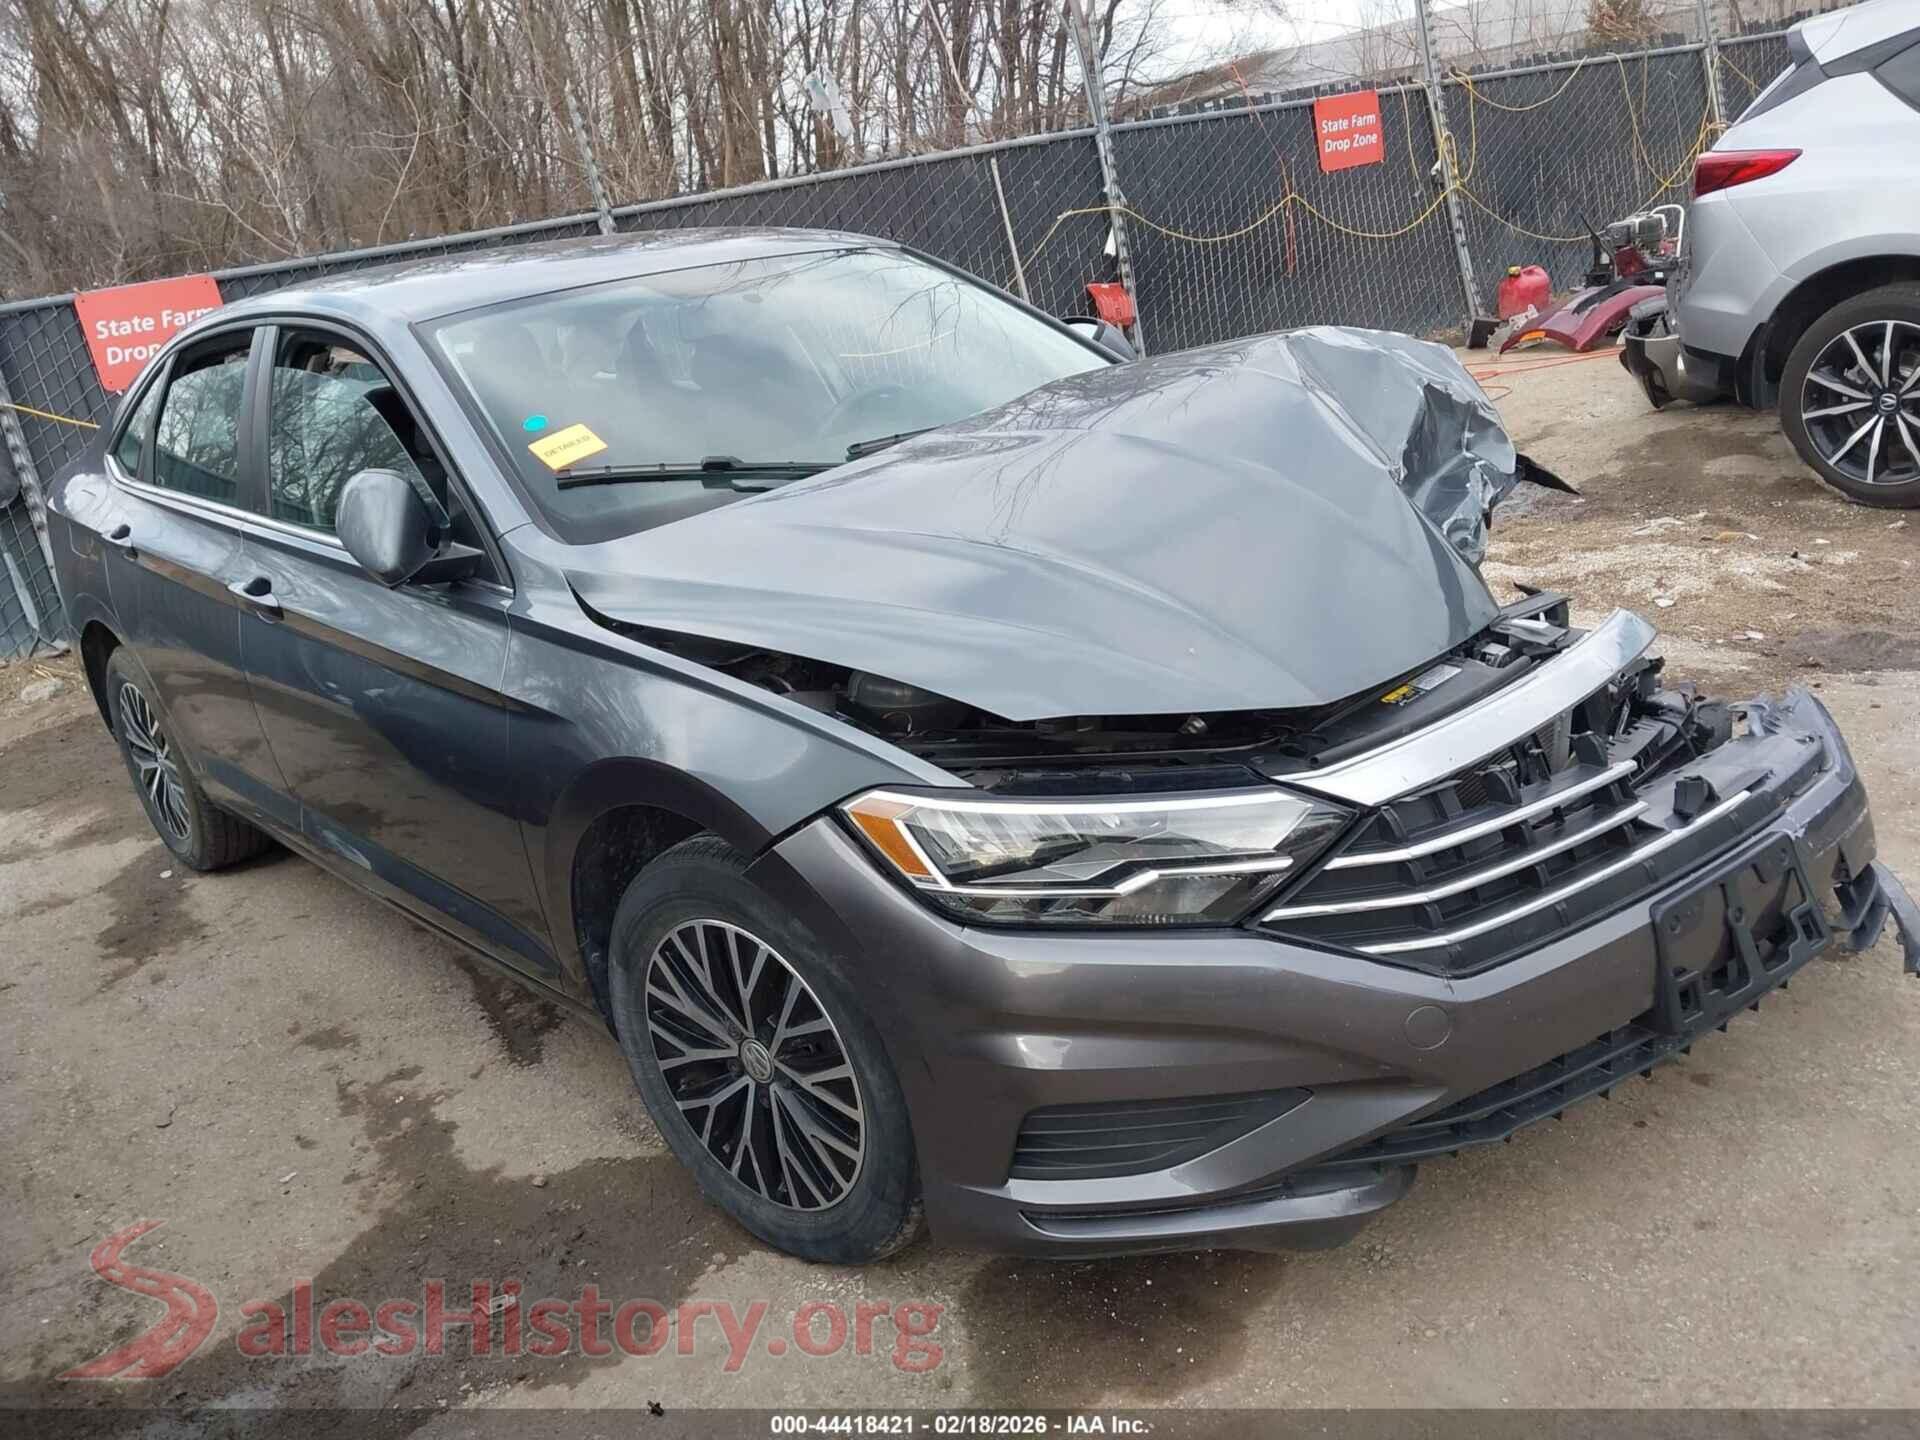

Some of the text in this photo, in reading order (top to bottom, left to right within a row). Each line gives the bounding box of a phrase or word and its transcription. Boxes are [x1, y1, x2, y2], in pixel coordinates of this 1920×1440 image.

[1321, 114, 1376, 133] State Farm
[1324, 133, 1378, 153] Drop Zone
[95, 315, 155, 340] State
